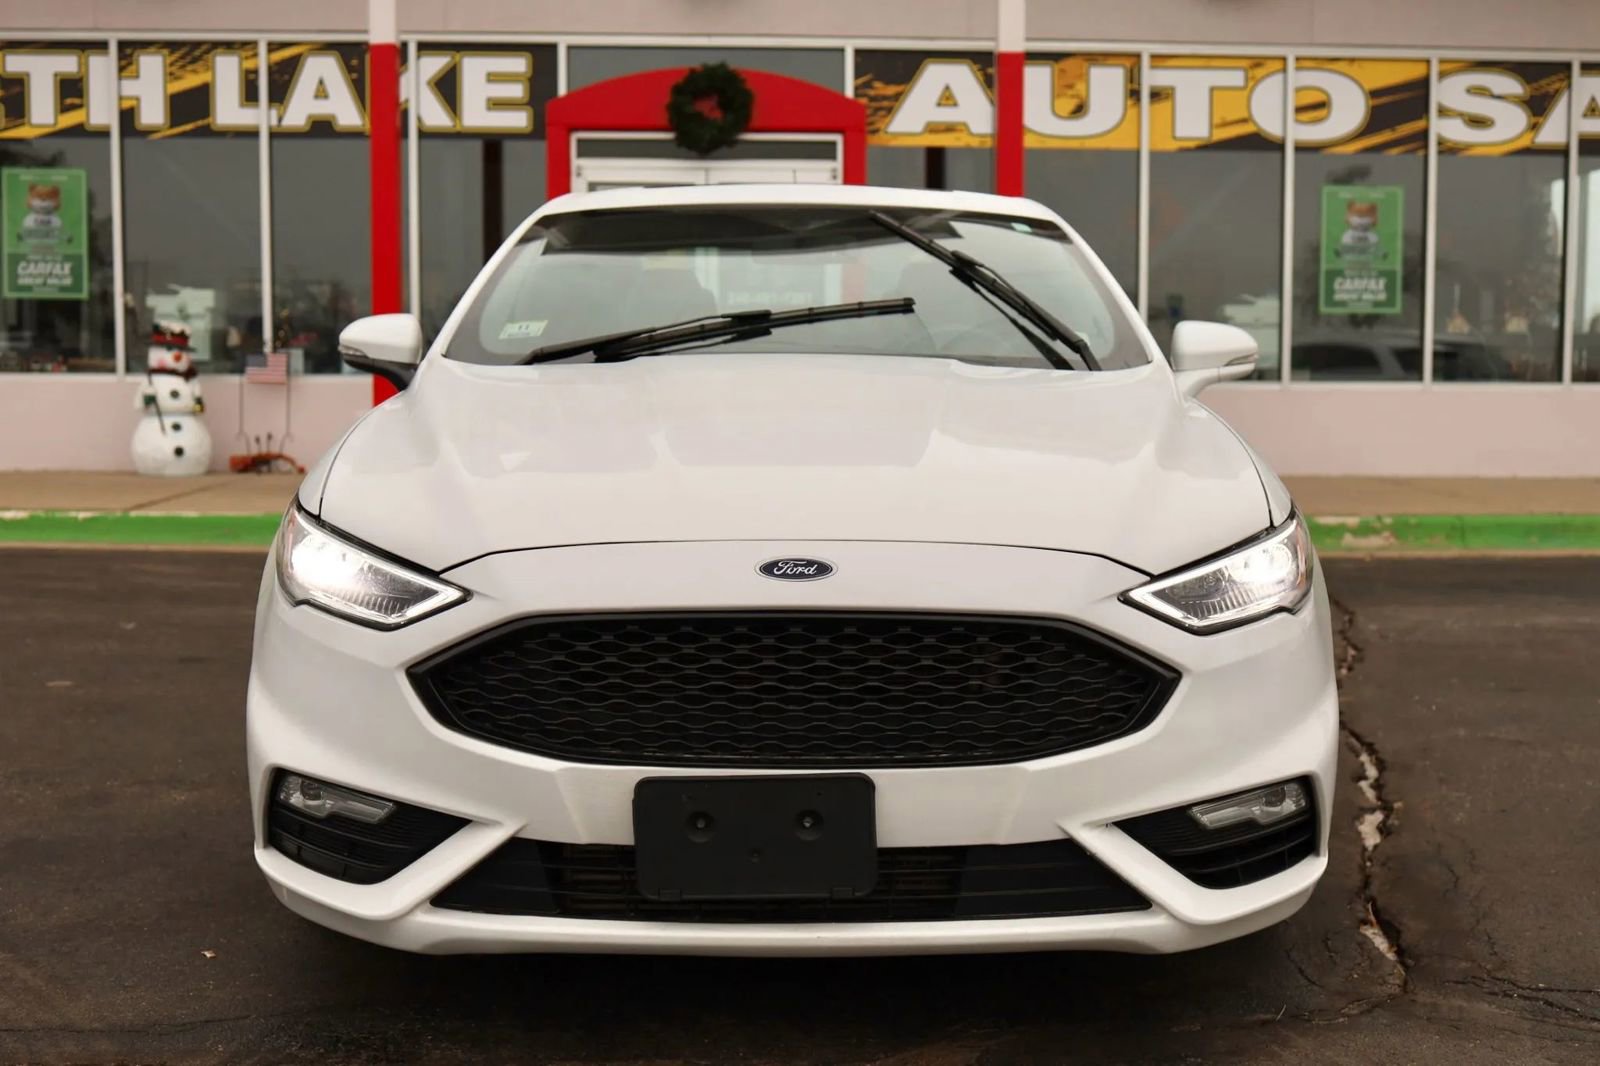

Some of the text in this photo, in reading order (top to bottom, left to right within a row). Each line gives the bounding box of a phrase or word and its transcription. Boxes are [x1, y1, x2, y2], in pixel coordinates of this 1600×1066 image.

[0, 49, 170, 131] TH
[210, 51, 534, 133] LAKE
[883, 59, 1371, 147] AUTO
[773, 560, 818, 575] Ford
